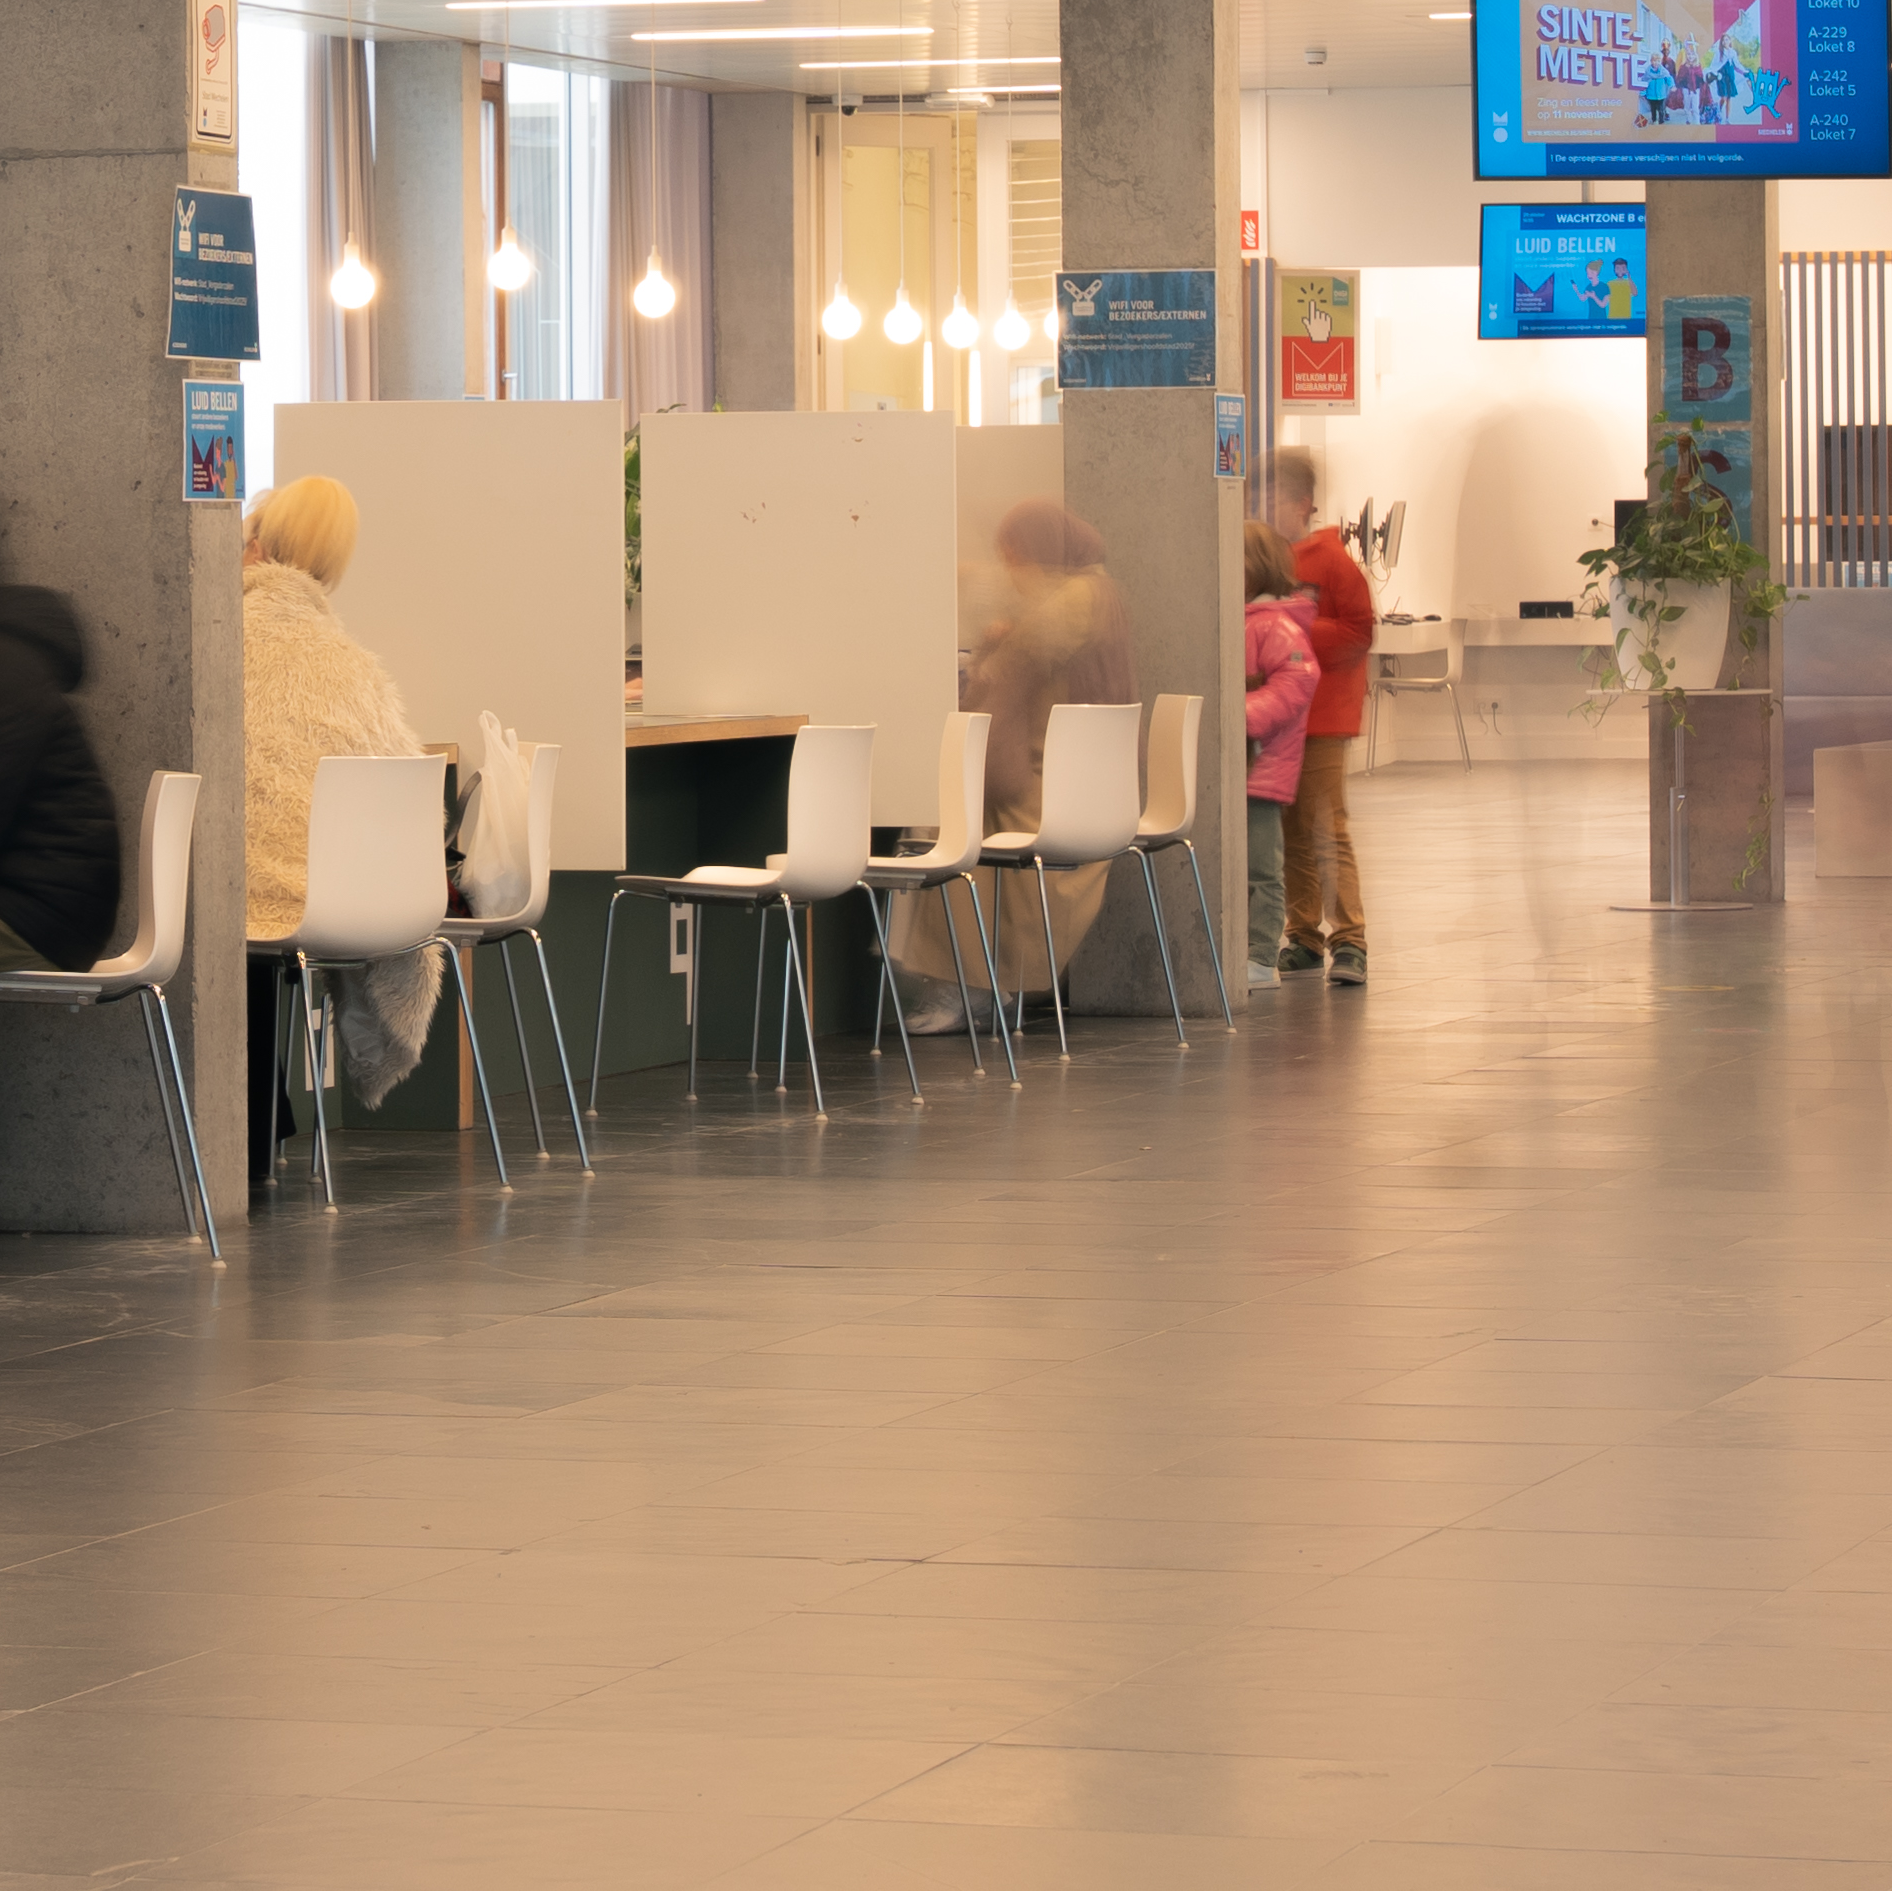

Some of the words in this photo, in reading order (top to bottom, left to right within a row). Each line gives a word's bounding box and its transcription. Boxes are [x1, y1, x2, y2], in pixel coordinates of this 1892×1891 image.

[1537, 4, 1644, 49] SINTE-
[1808, 27, 1847, 39] A-229
[1809, 41, 1844, 53] Loket
[1847, 41, 1855, 53] 8
[1537, 43, 1650, 91] METTE
[1809, 70, 1848, 82] A-242
[1810, 85, 1845, 97] Loket
[1848, 85, 1856, 97] 5
[1537, 98, 1558, 109] Zing
[1575, 98, 1599, 107] feest
[1537, 112, 1550, 120] op
[1552, 110, 1561, 119] 11
[1564, 110, 1614, 119] november
[1810, 114, 1848, 126] A-240
[1811, 129, 1846, 141] Loket
[1849, 129, 1856, 140] 7
[1557, 214, 1624, 223] WACHTZONE
[1627, 213, 1635, 223] B
[1516, 238, 1551, 254] LUID
[1558, 237, 1616, 254] BELLEN
[1109, 300, 1128, 310] WIFI
[1131, 300, 1154, 309] VOOR
[1109, 310, 1206, 321] BEZOEKERS/EXTERNEN
[1681, 317, 1733, 402] B
[1295, 373, 1326, 382] WELKOM
[1340, 373, 1348, 382] JE
[192, 391, 209, 410] LUID
[210, 391, 237, 411] BELLEN
[670, 901, 693, 1025] 9
